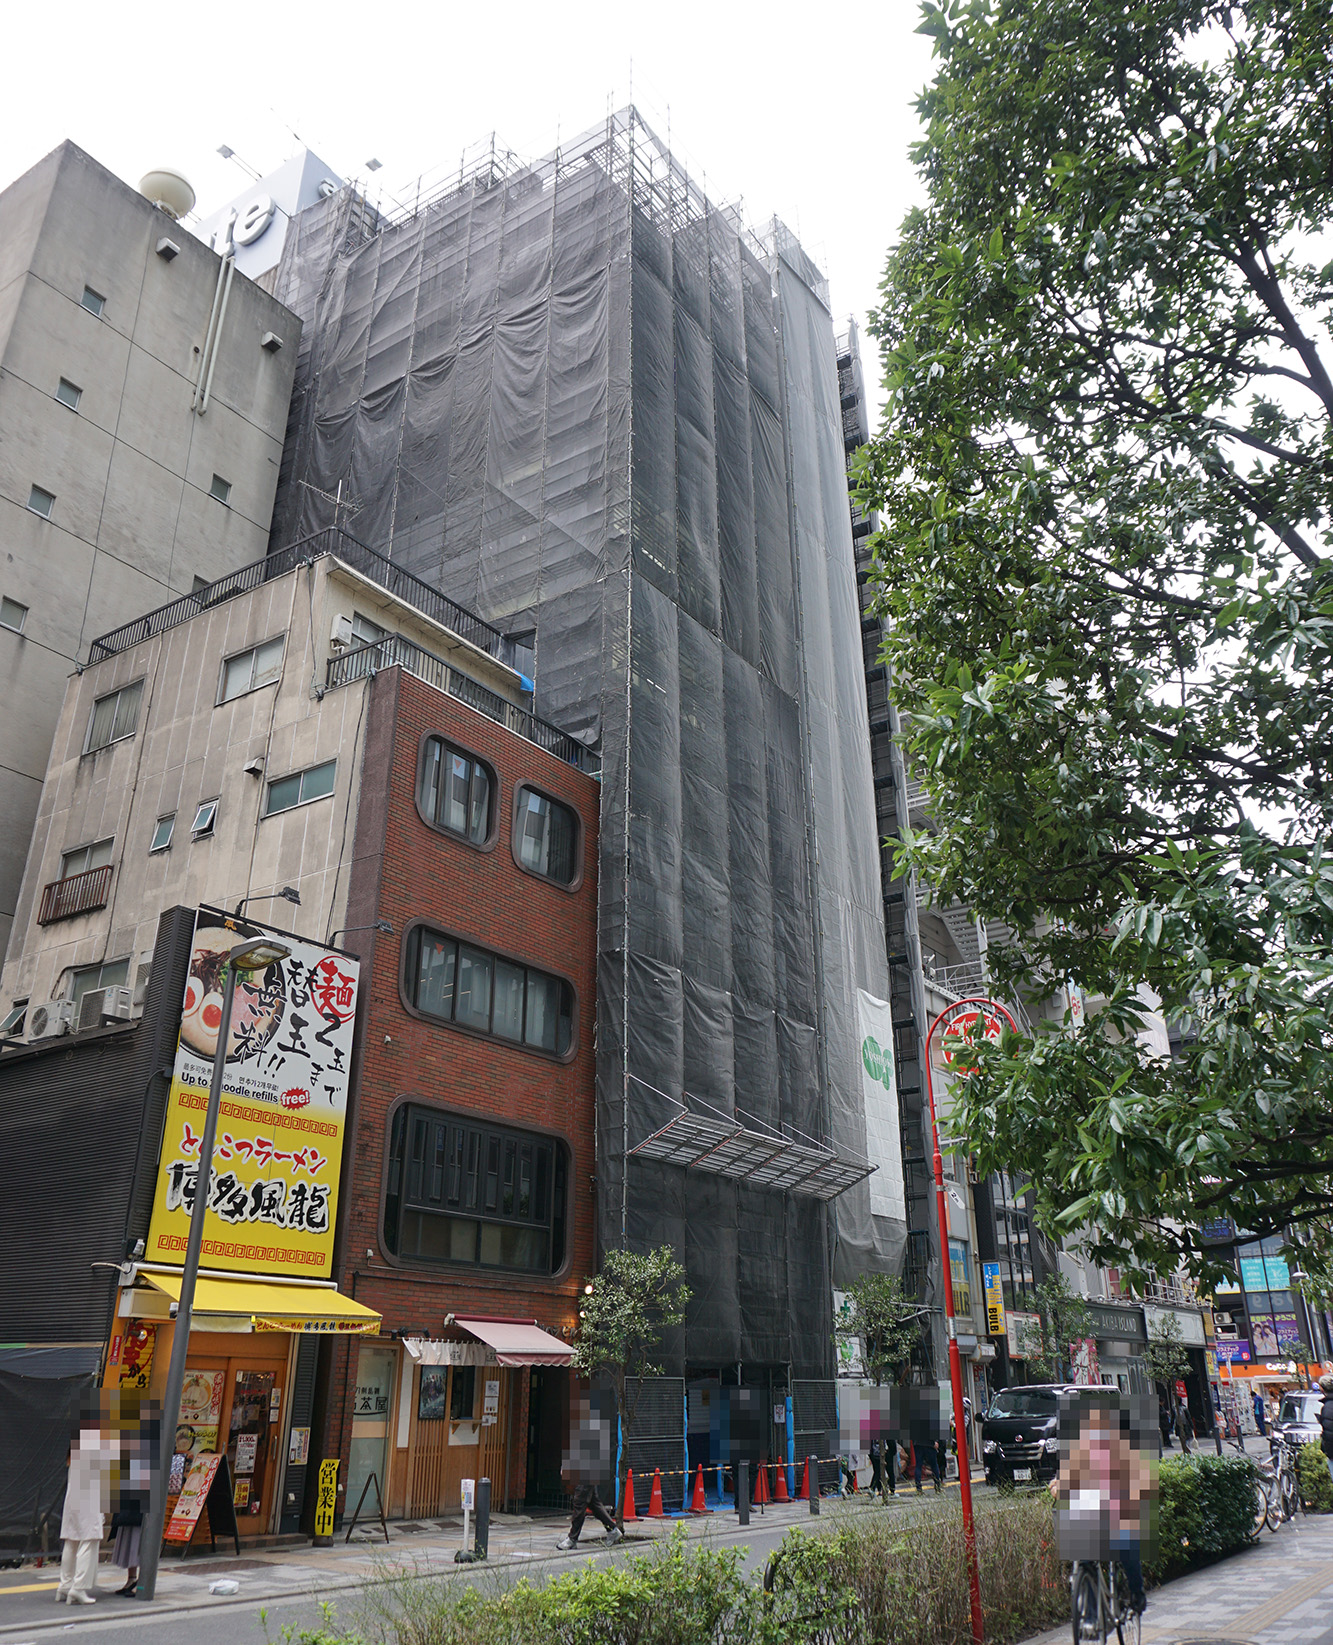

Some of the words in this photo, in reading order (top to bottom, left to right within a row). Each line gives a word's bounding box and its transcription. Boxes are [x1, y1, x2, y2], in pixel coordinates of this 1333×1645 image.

[181, 1072, 196, 1086] Up
[197, 1076, 208, 1087] to
[251, 1090, 278, 1103] refills
[281, 1089, 310, 1106] free!
[988, 1307, 999, 1332] BULB
[317, 1462, 336, 1534] 営業中
